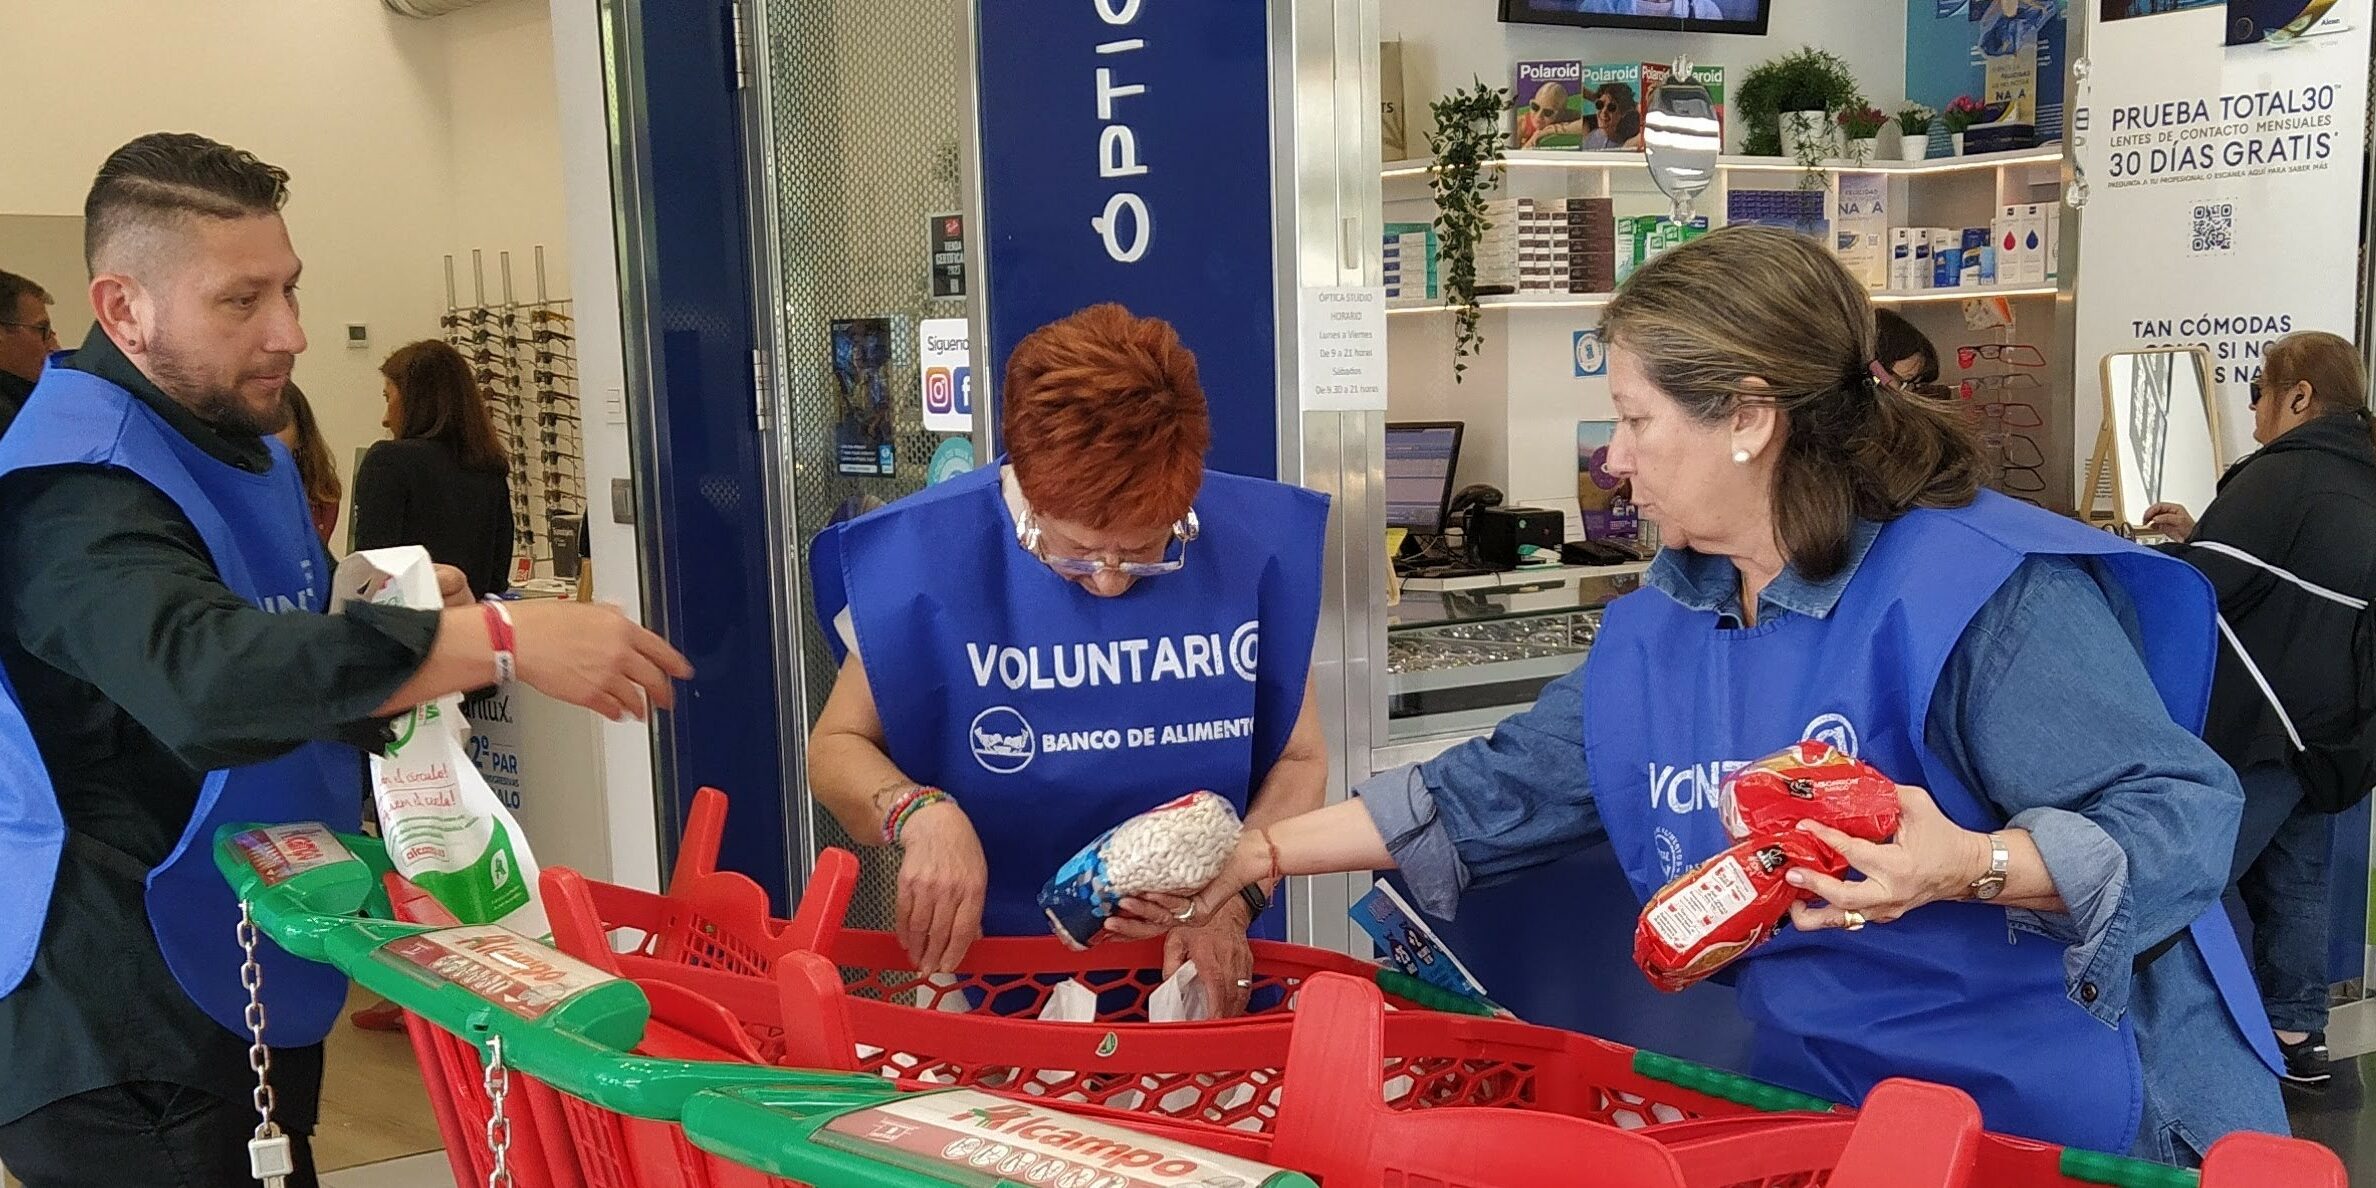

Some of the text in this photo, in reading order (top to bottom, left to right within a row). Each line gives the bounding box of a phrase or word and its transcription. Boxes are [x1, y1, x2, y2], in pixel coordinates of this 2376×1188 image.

[1520, 63, 1580, 79] Polaroid
[1583, 67, 1639, 82] Polaroid
[1692, 69, 1722, 83] aroid
[1381, 102, 1394, 113] TS
[2112, 99, 2210, 131] PRUEBA
[2110, 114, 2332, 148] LENTES DE CONTACTO MENSUALES
[2109, 151, 2141, 177] 30
[2150, 140, 2214, 174] DÍAS
[2132, 313, 2292, 338] TAN CÓMODAS
[2218, 341, 2236, 359] SI
[2214, 366, 2226, 383] S
[1042, 730, 1120, 752] BANCO
[1127, 727, 1155, 748] DE
[492, 752, 518, 775] PAR
[492, 786, 520, 809] ALO
